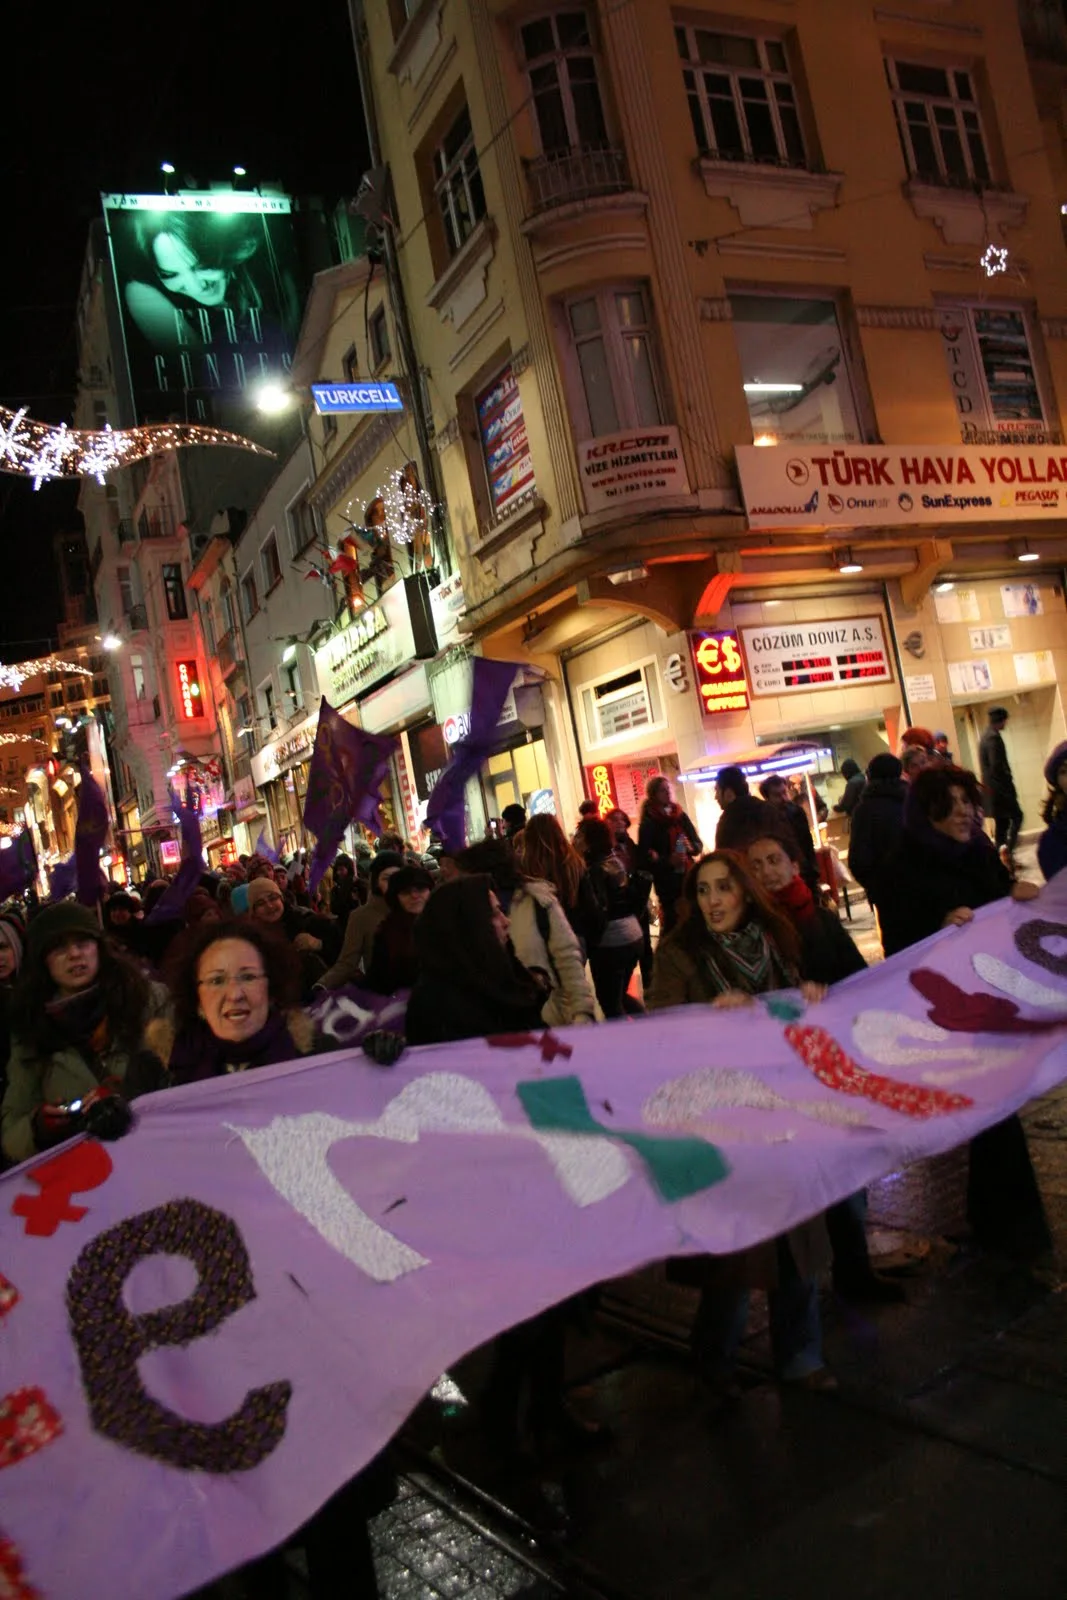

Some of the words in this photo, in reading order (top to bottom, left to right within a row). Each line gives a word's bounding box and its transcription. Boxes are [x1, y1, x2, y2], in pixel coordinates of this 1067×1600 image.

[315, 389, 399, 405] TURKCELL
[611, 448, 678, 469] HİZMETLERİ
[812, 450, 894, 486] TÜRK
[900, 456, 976, 485] HAVA
[921, 494, 993, 510] SunExpress
[1015, 489, 1060, 502] PEGASUS
[752, 630, 804, 653] ÇÖZÜM
[808, 627, 848, 646] DÖVİZ
